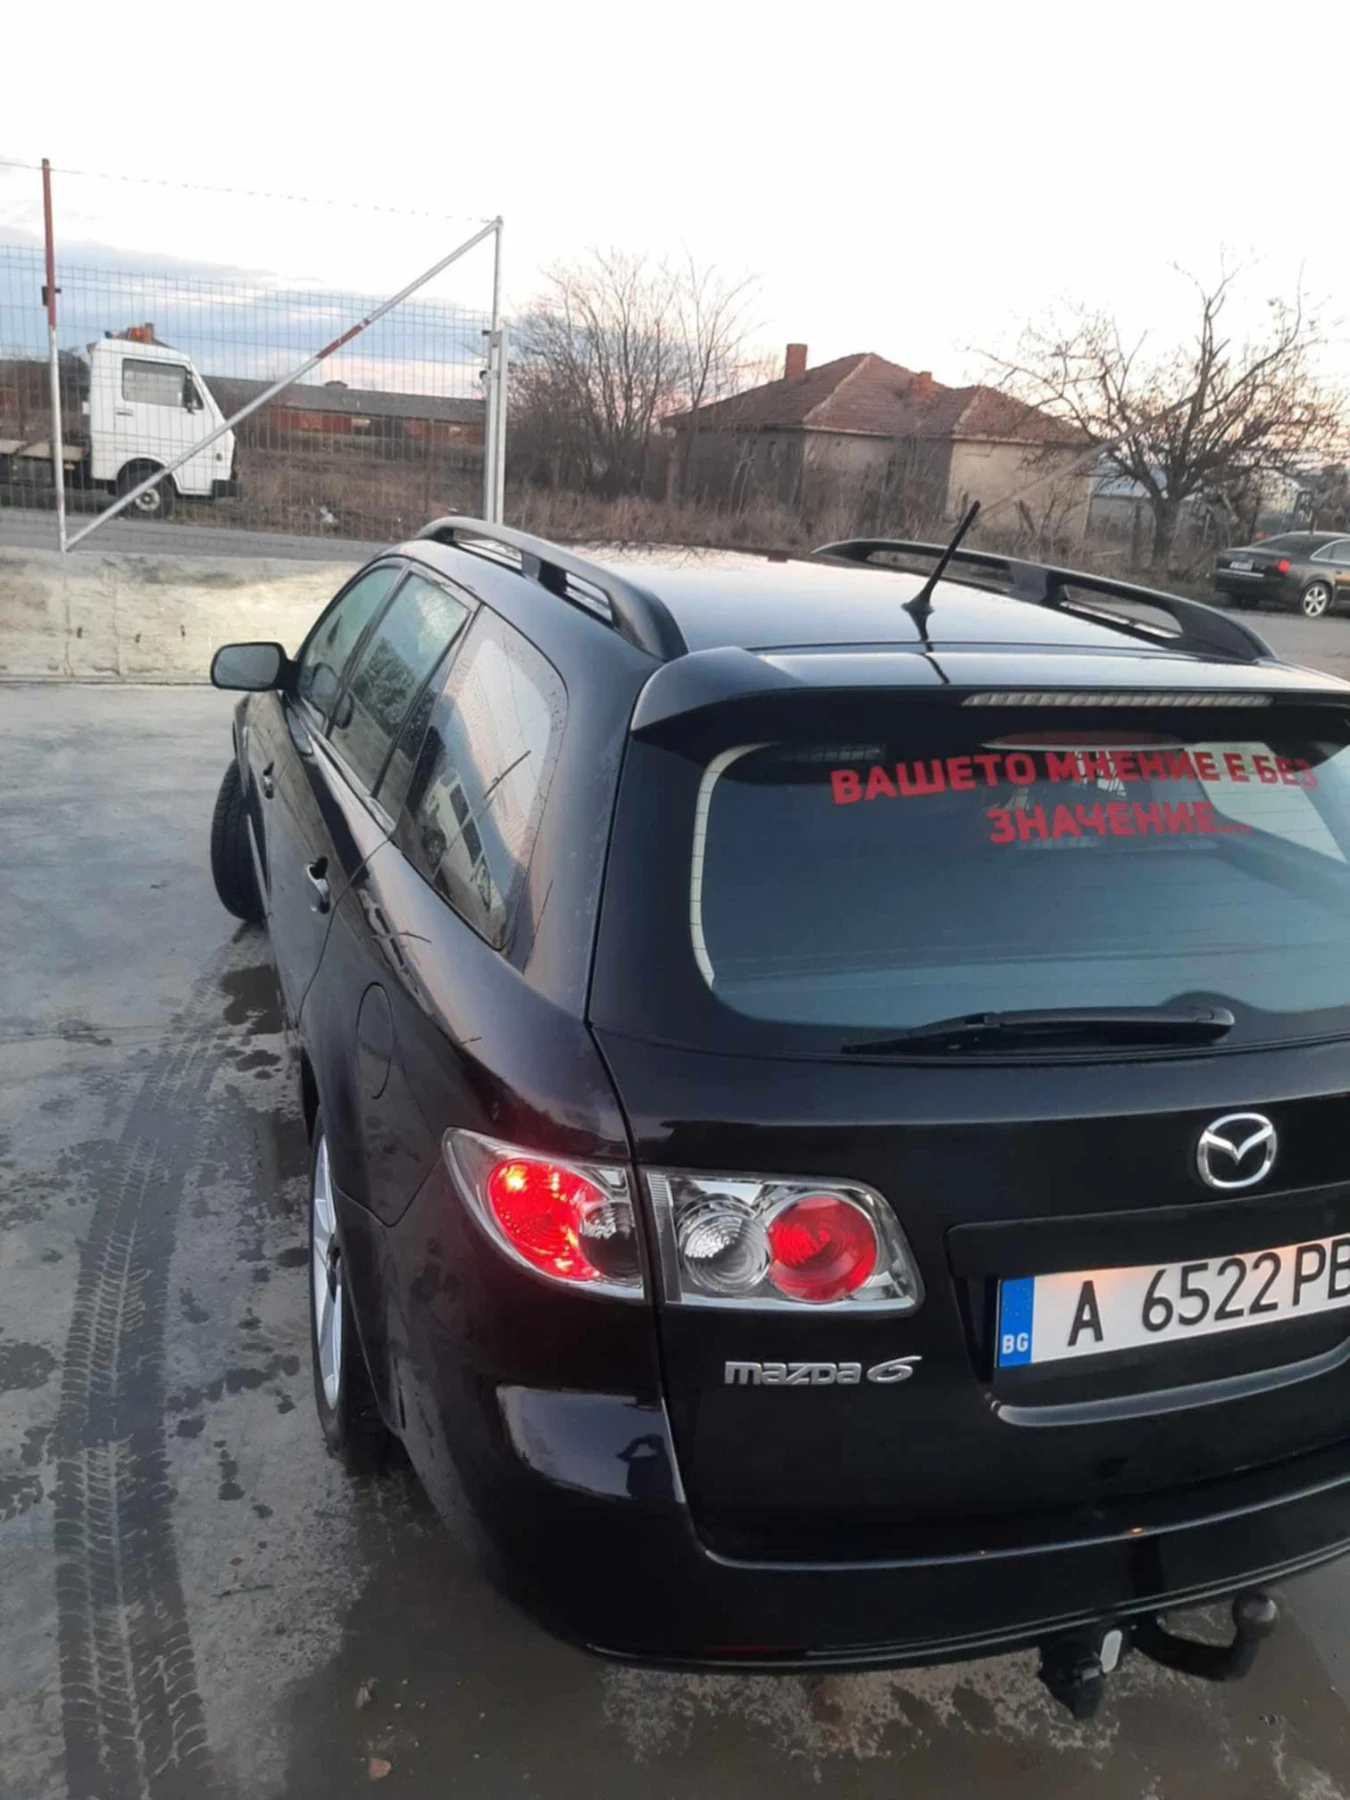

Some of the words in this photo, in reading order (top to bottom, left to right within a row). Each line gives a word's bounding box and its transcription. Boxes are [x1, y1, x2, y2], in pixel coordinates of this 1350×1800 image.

[831, 753, 1036, 804] ВАШЕТО
[1044, 750, 1219, 784] МНЕНИЕ
[1223, 752, 1250, 783] Е
[1251, 754, 1317, 789] БЕЗ
[1142, 1251, 1281, 1332] 6522
[1002, 1332, 1029, 1356] BG
[866, 1355, 923, 1384] 6
